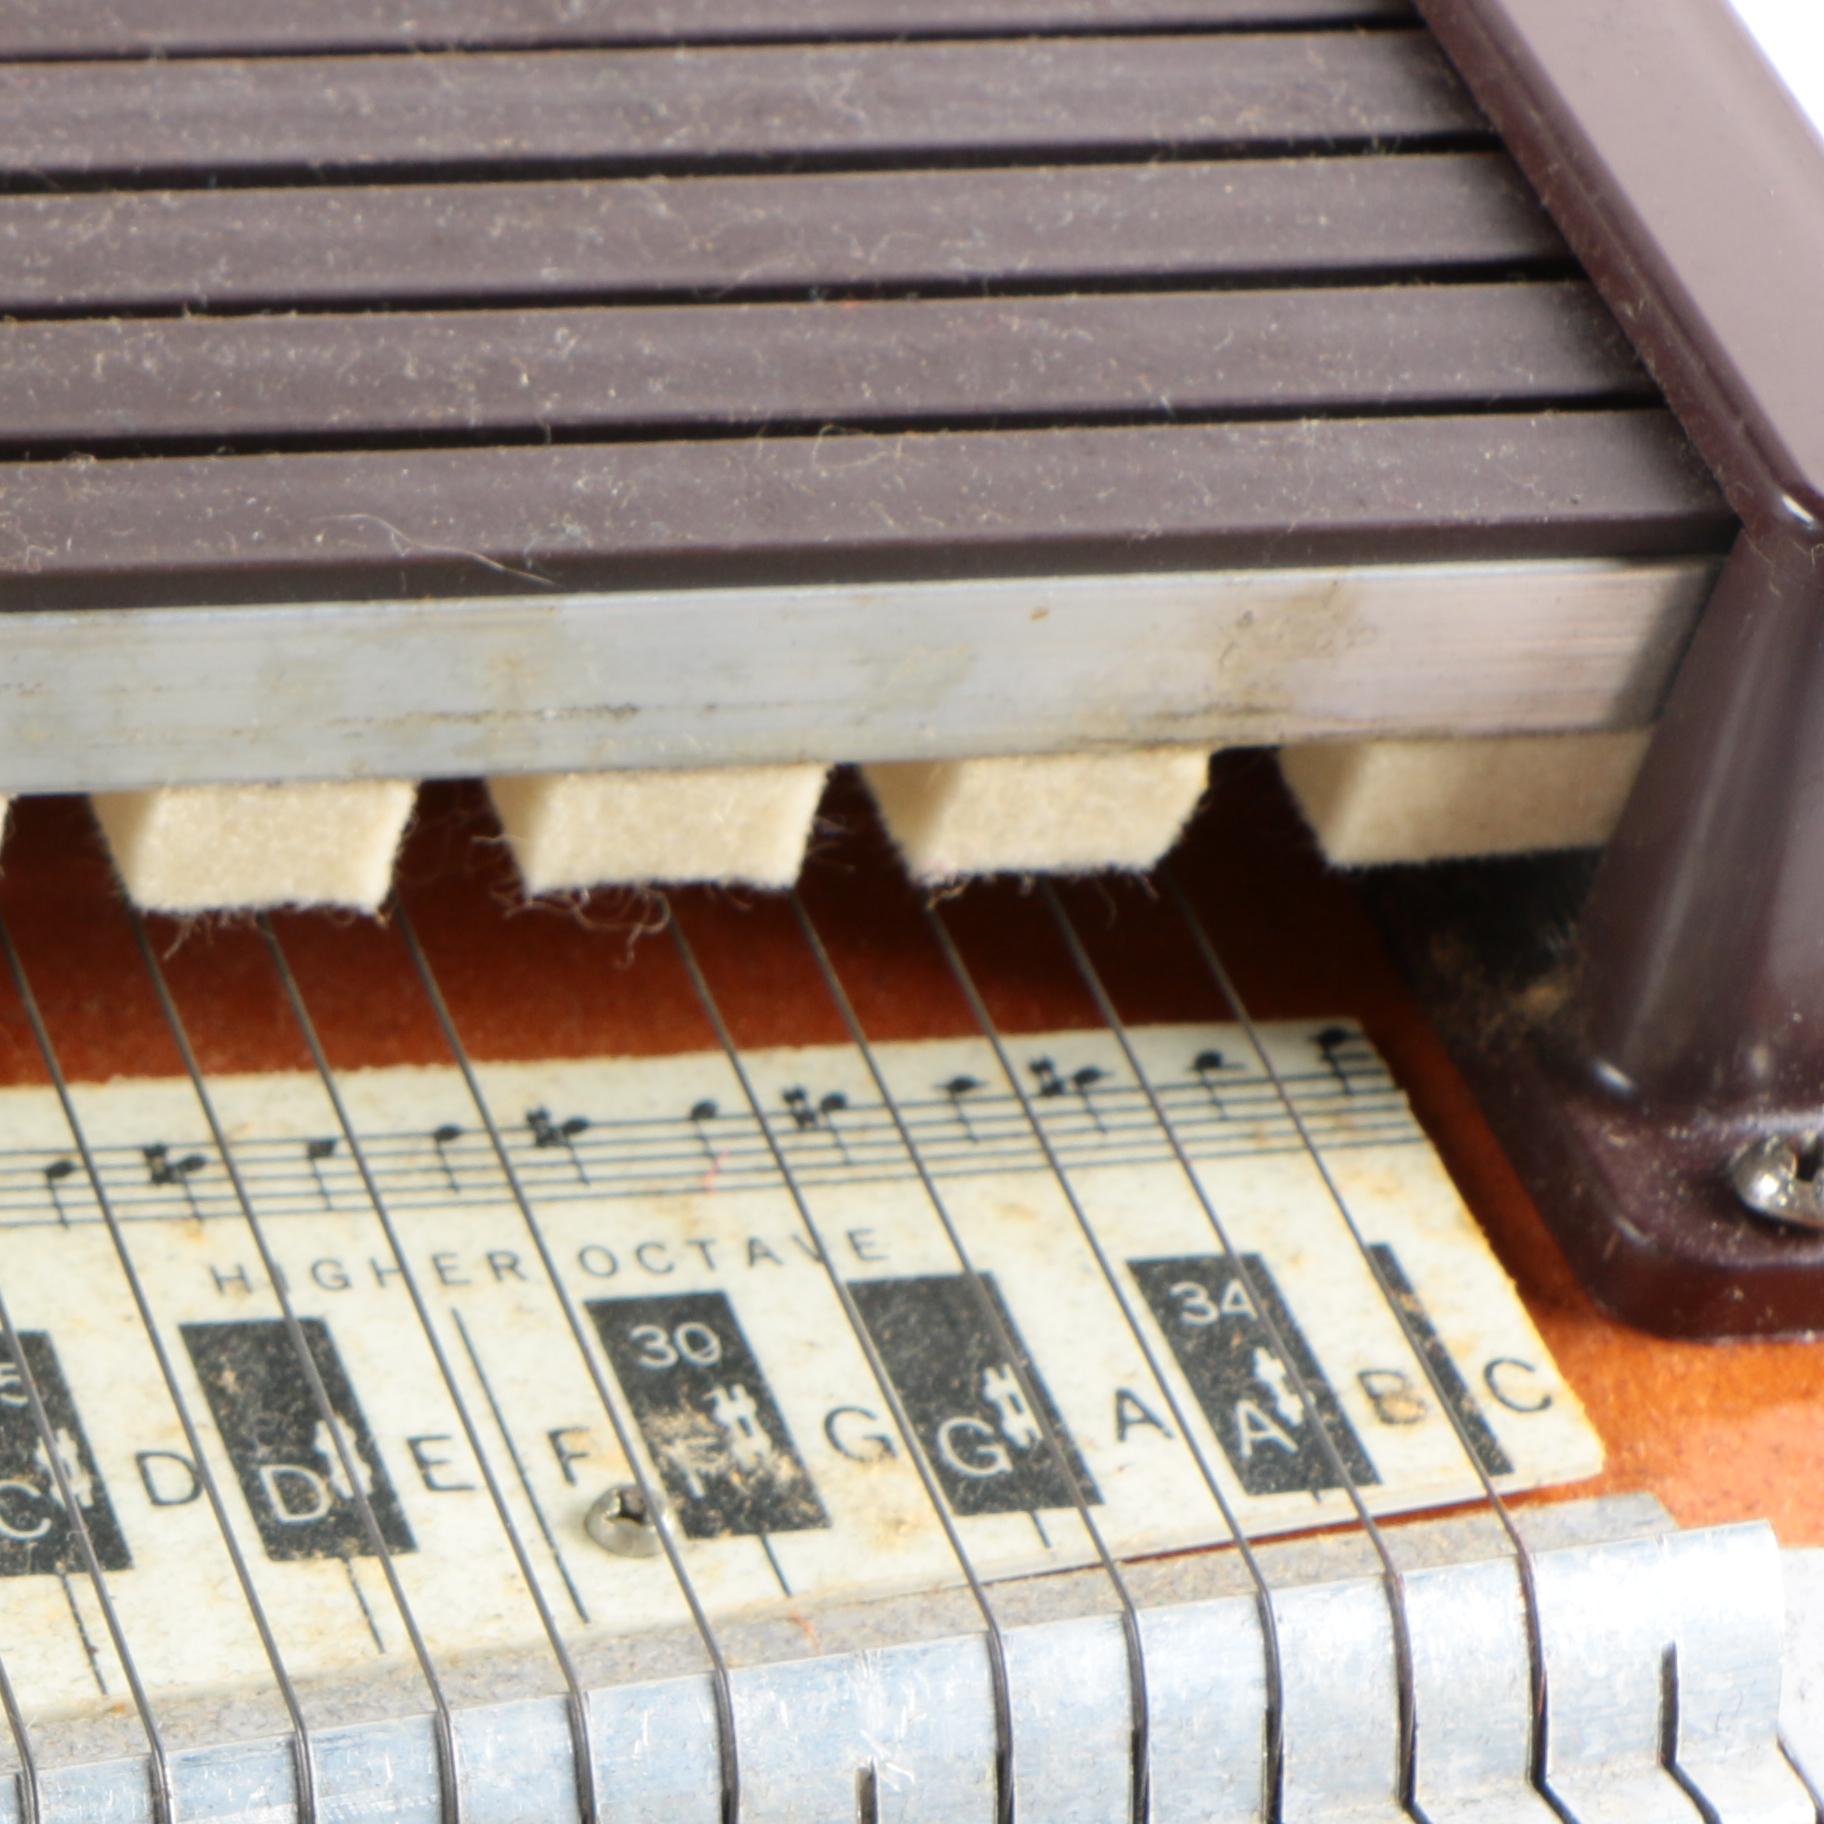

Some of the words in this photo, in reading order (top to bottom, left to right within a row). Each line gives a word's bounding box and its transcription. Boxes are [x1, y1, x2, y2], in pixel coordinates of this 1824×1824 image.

[578, 1227, 891, 1279] OCTAVE
[1169, 1281, 1256, 1325] 34
[630, 1321, 722, 1368] 30
[136, 1452, 204, 1506] D
[409, 1435, 476, 1492] E
[549, 1428, 590, 1485] F
[823, 1406, 898, 1463] G
[1115, 1386, 1175, 1443] A
[1358, 1368, 1426, 1426] B
[1484, 1356, 1552, 1412] C
